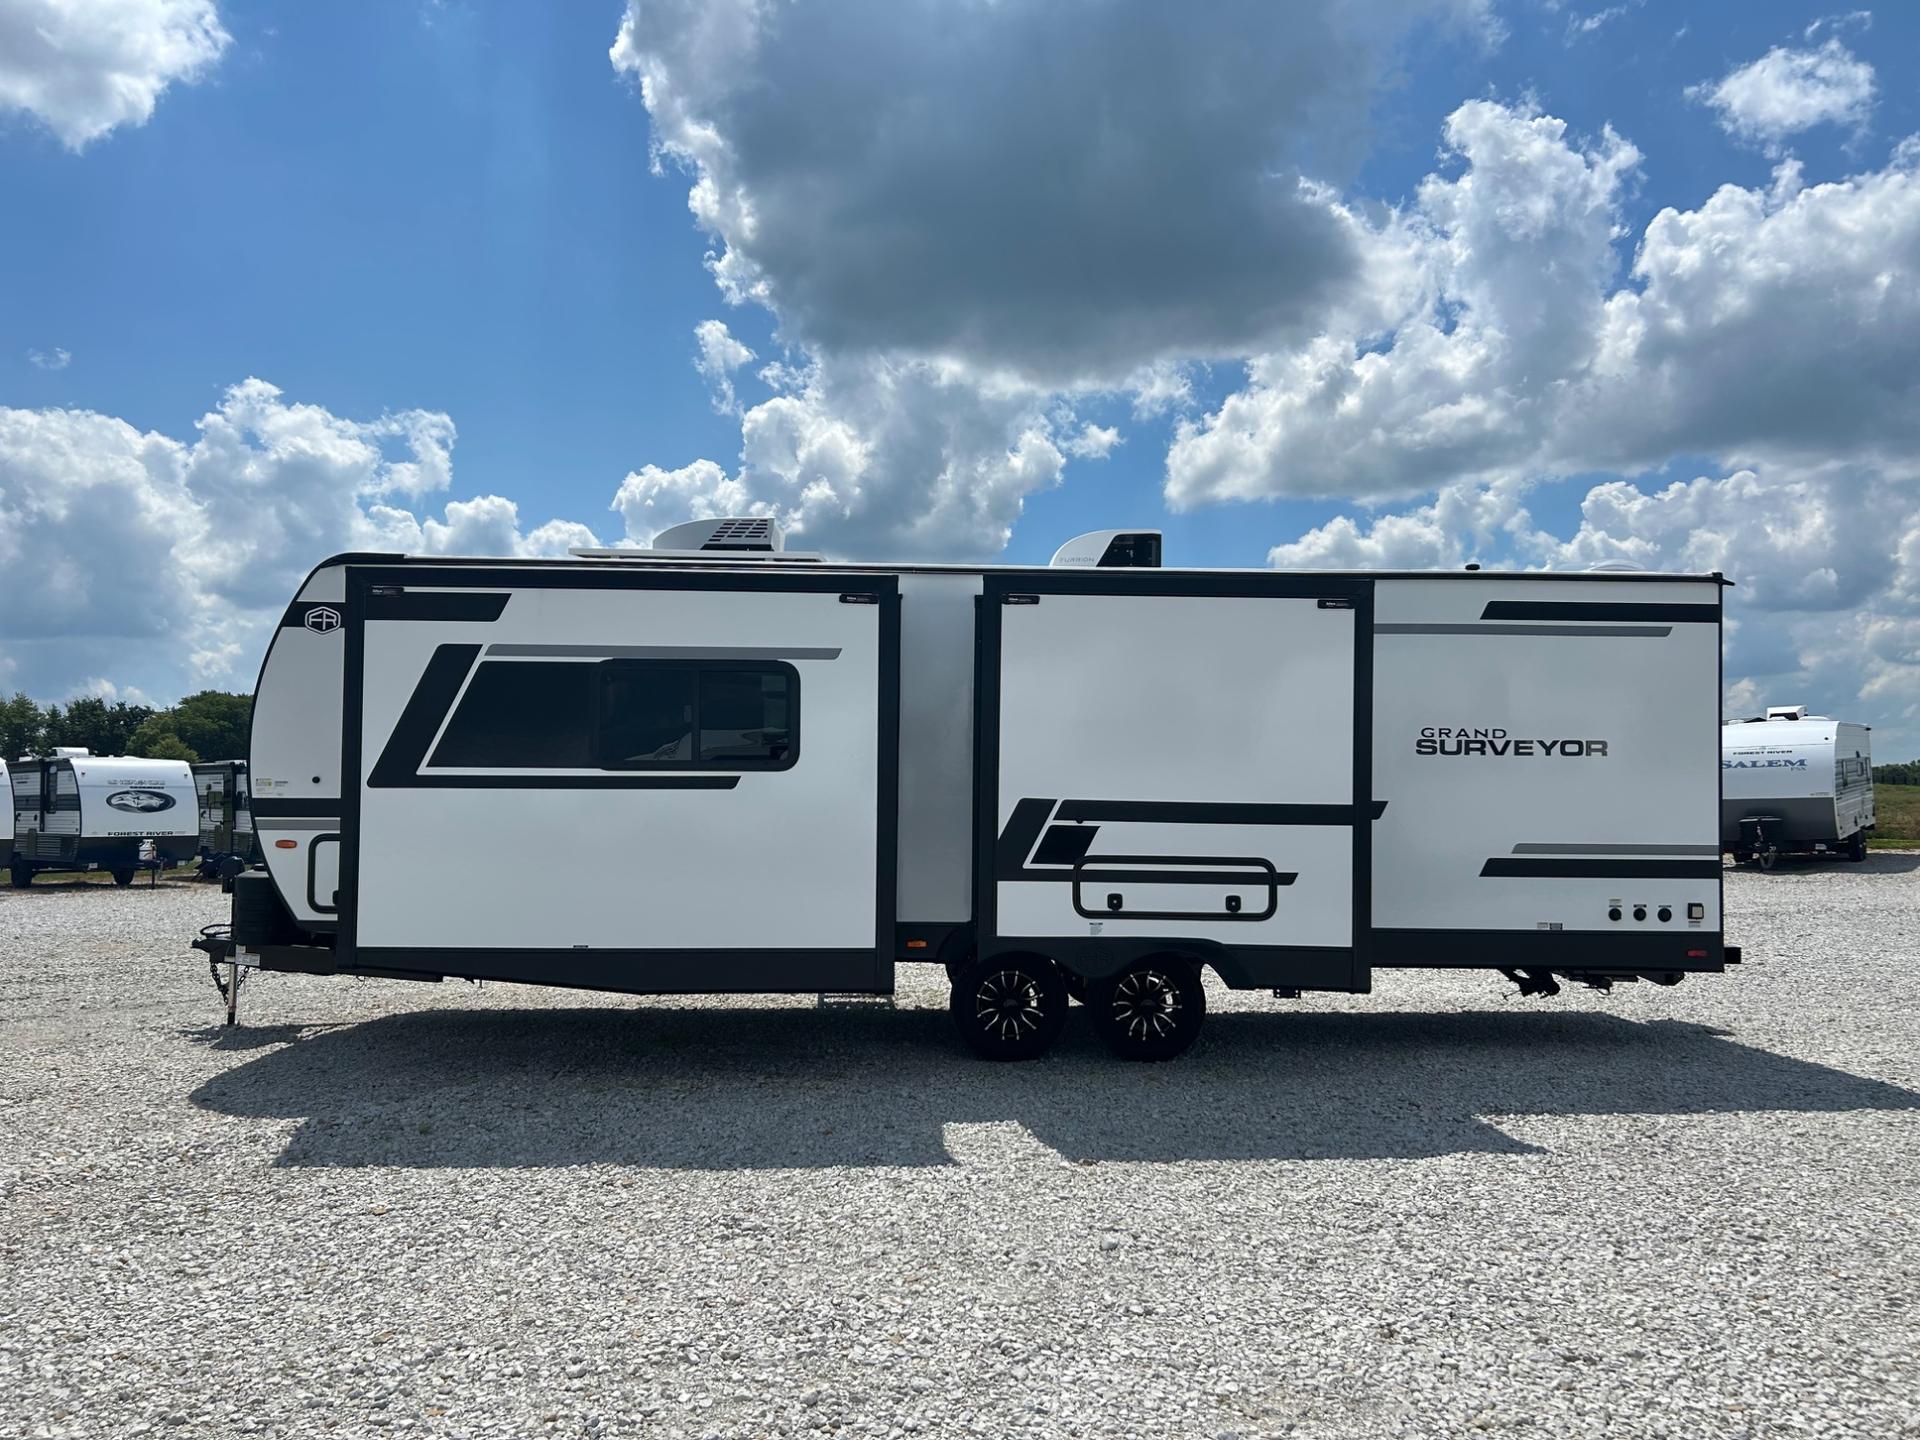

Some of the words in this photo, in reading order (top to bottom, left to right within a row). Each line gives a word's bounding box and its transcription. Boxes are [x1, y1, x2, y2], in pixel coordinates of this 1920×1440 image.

[1420, 727, 1507, 739] GRAND
[1415, 739, 1609, 757] SURVEYOR
[1722, 758, 1808, 769] SALEM
